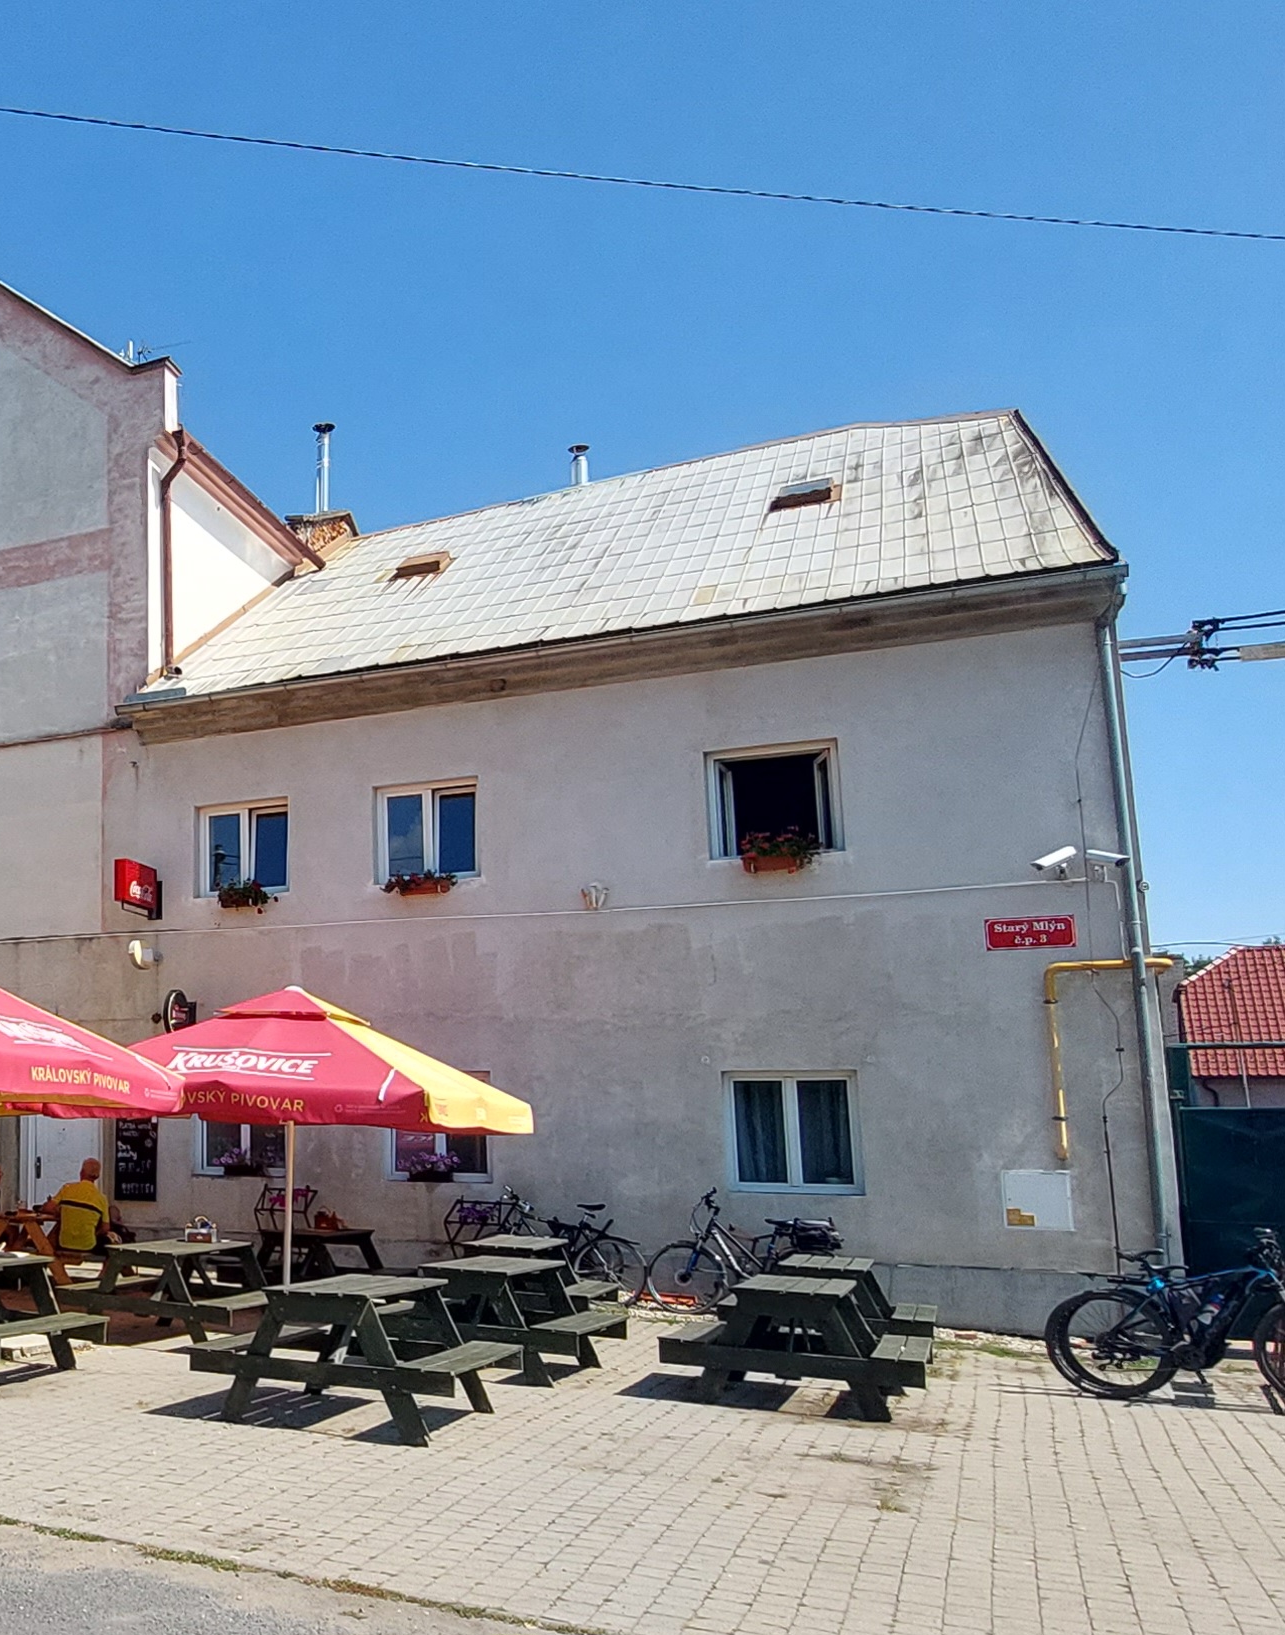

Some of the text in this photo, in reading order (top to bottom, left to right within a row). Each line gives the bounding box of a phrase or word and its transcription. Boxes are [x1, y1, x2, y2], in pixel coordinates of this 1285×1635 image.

[994, 920, 1066, 934] Starý Mlýn
[1039, 934, 1047, 943] 3
[170, 1051, 318, 1075] KRUŠOVICE
[31, 1066, 92, 1085] KRÁLOVSKÝ
[93, 1073, 131, 1095] PIVOVAR
[231, 1093, 304, 1112] PIVOVAR
